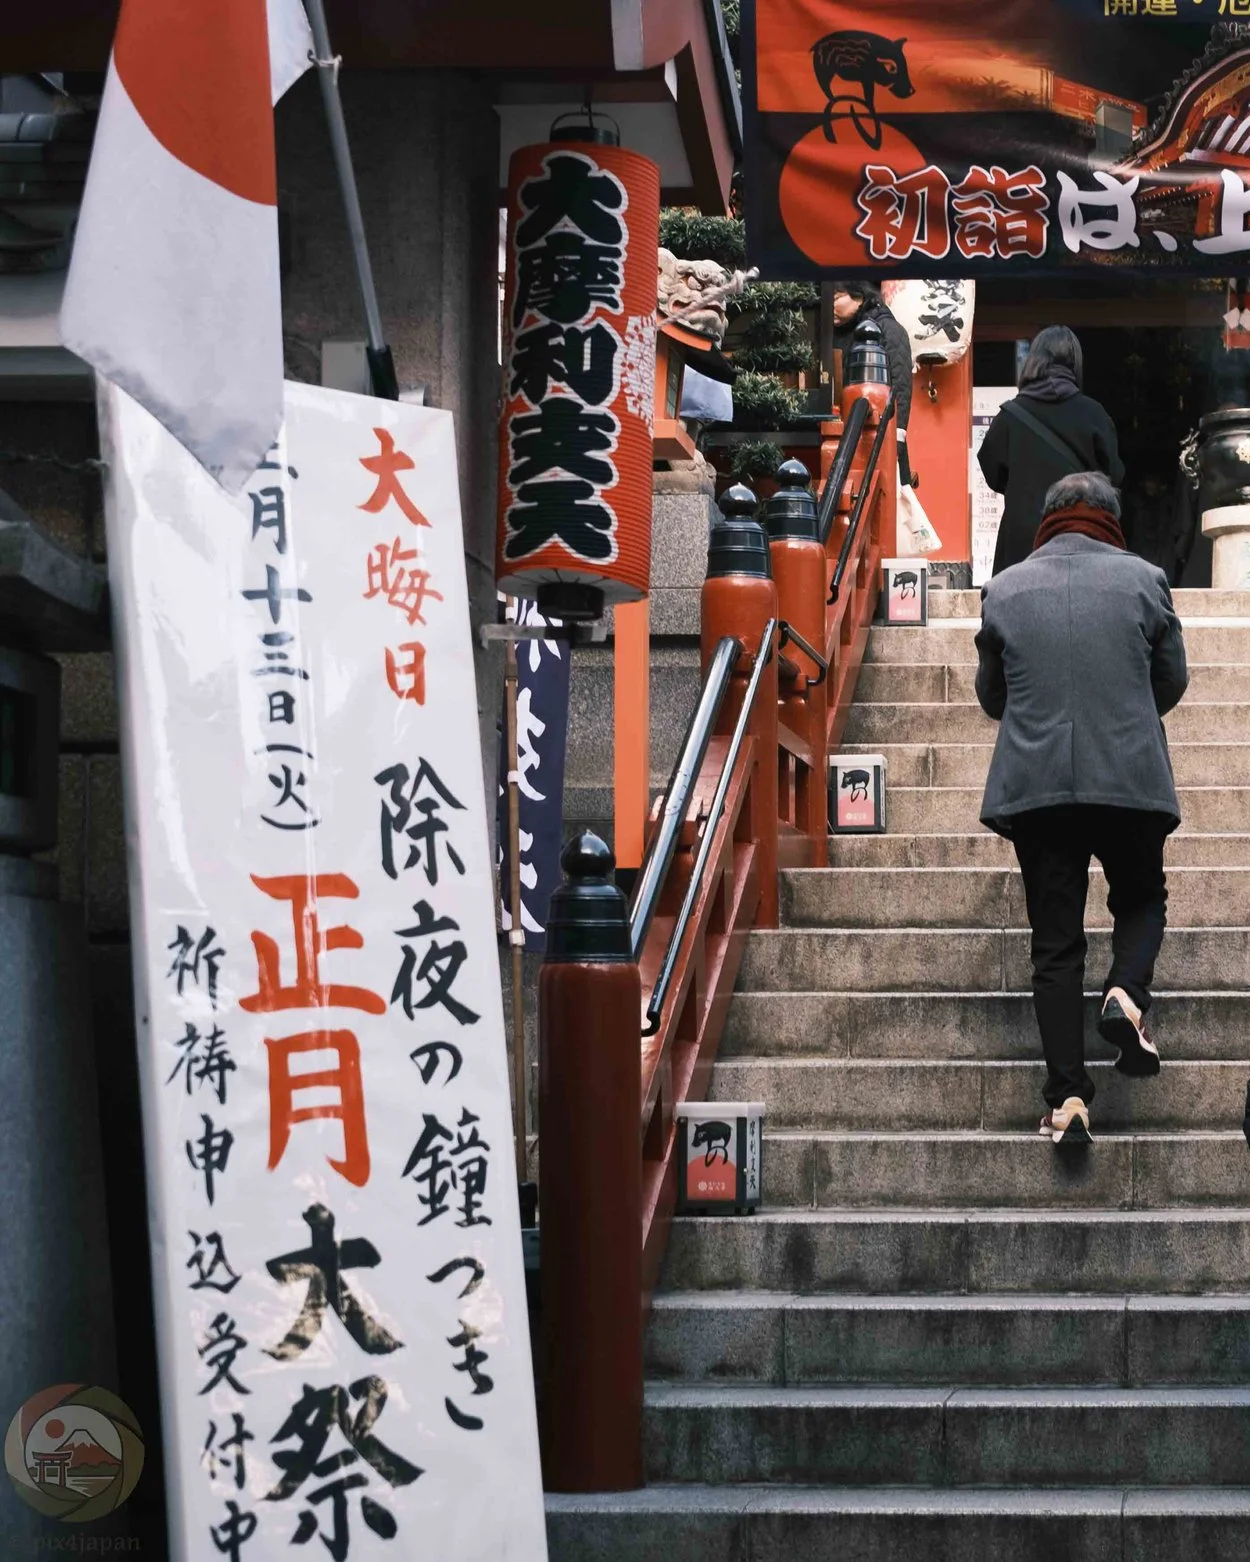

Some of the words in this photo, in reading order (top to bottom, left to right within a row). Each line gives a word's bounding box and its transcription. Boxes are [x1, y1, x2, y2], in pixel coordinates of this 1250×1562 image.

[360, 428, 443, 706] 大晦日
[504, 153, 626, 564] 大摩利支天
[239, 873, 426, 1562] 正月大祭
[373, 756, 496, 1431] 除夜の鐘つき
